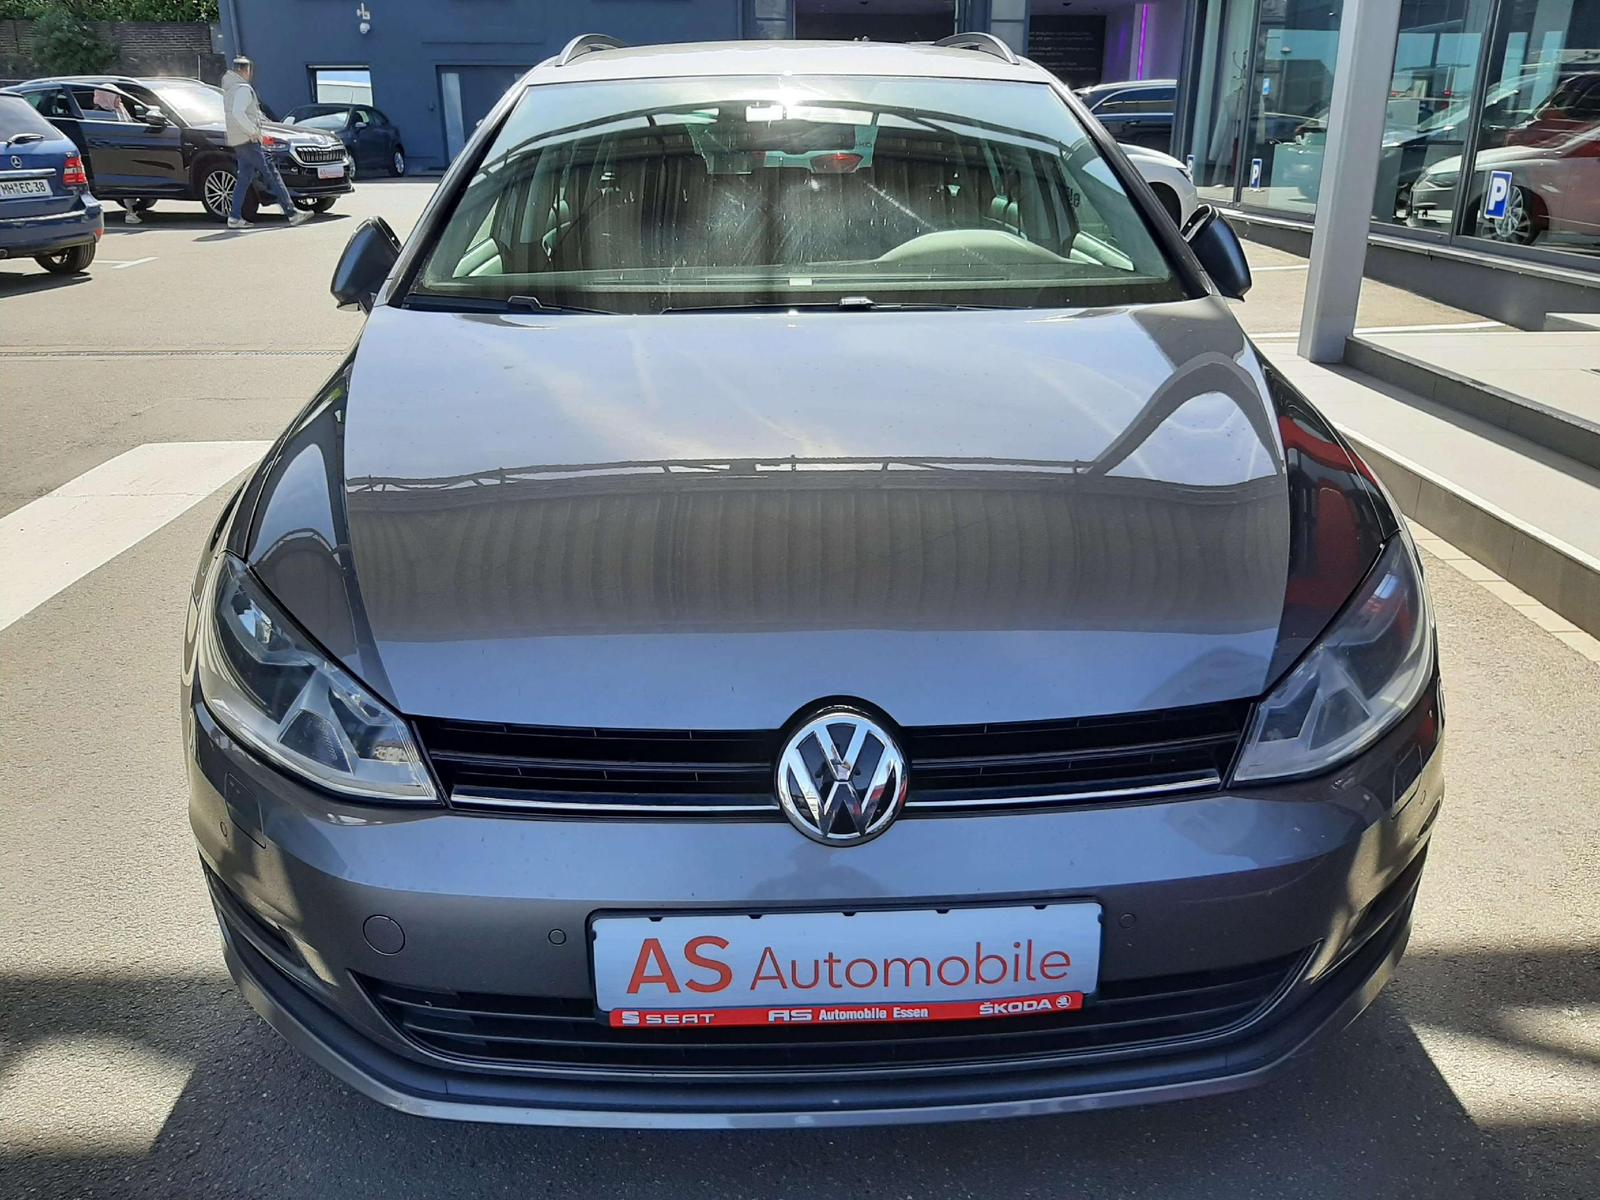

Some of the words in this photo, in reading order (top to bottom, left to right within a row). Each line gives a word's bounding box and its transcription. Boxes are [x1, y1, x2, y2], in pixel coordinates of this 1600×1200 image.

[1251, 164, 1260, 184] P
[19, 182, 33, 194] EC
[34, 181, 46, 192] 38
[1488, 177, 1507, 211] P
[626, 935, 733, 994] AS
[750, 938, 1072, 991] Automobile
[768, 1009, 812, 1023] AS
[818, 1007, 887, 1022] Automobile
[893, 1006, 929, 1019] Essen
[979, 1000, 1053, 1015] ŠKODA
[645, 1013, 715, 1025] SEAT
